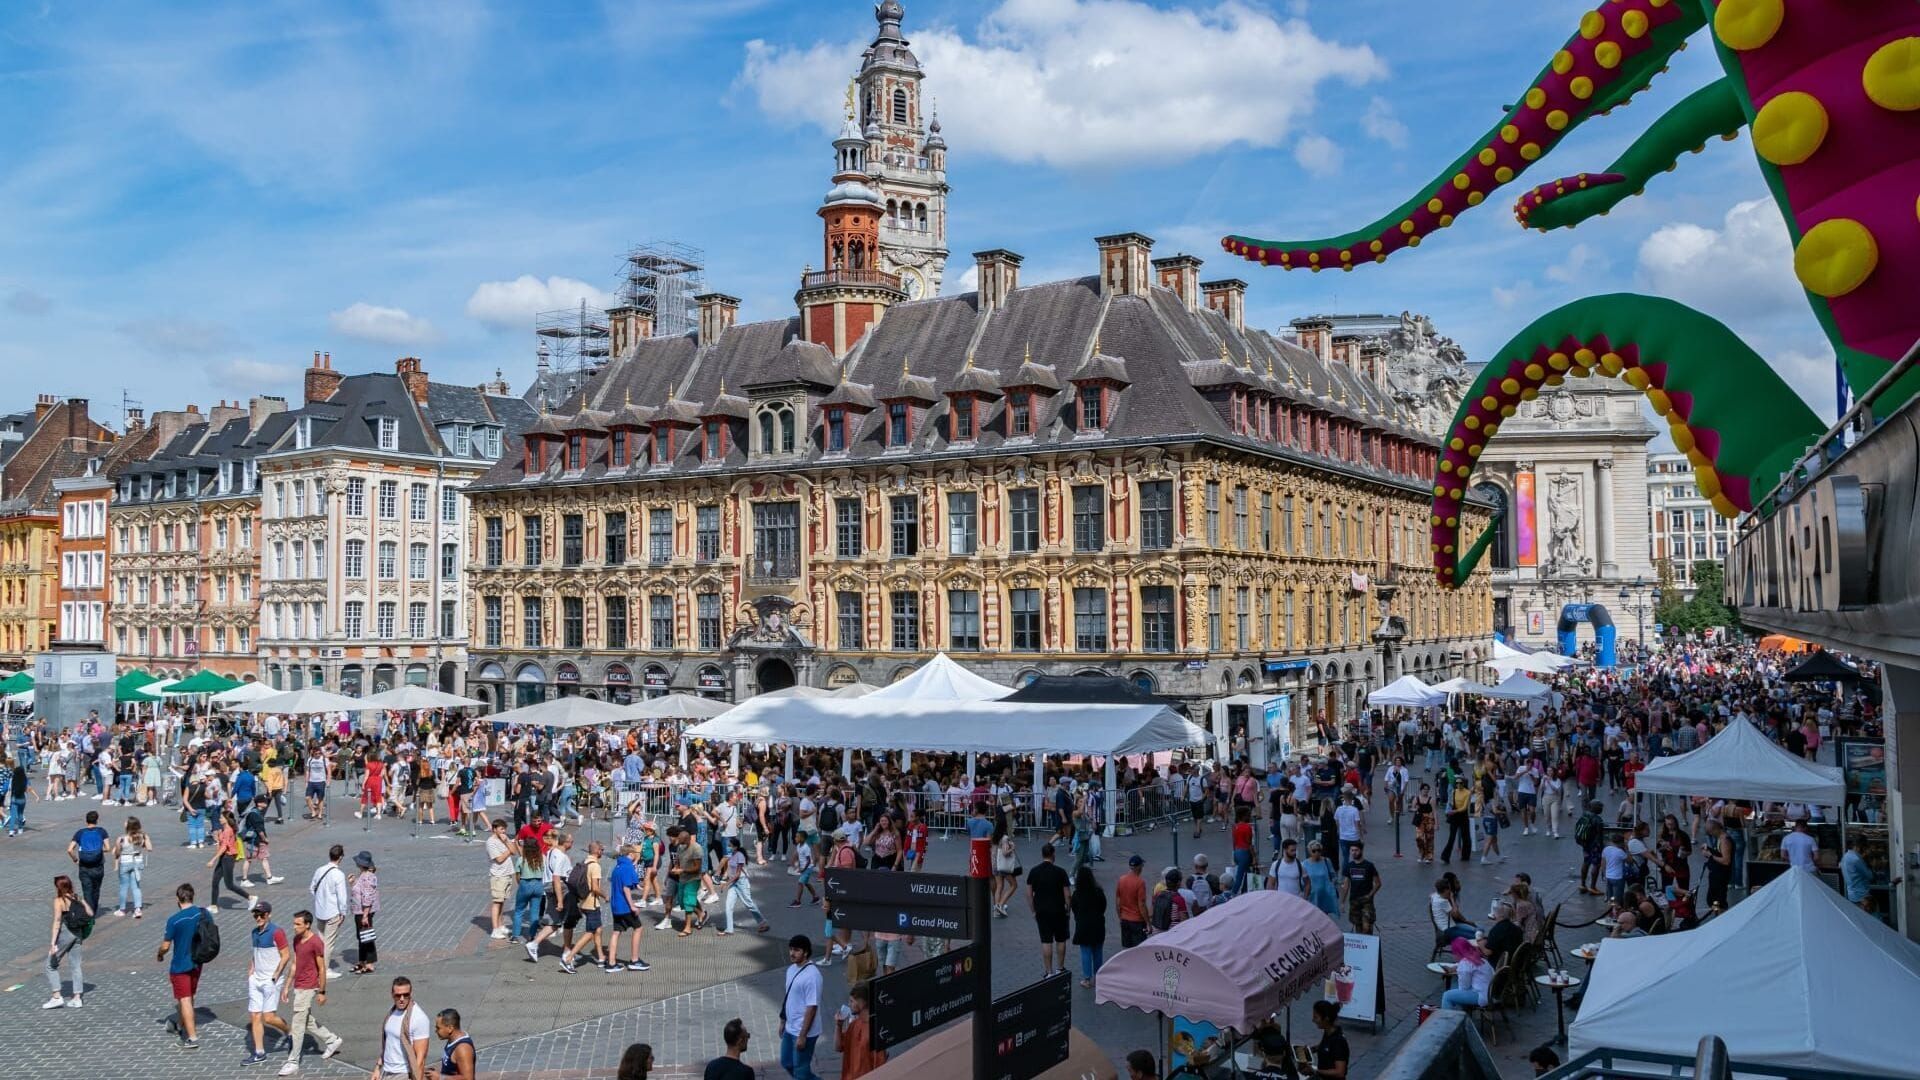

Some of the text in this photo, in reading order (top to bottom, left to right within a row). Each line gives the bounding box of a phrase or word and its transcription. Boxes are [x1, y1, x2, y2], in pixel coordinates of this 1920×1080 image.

[910, 883, 958, 896] VIEUX LILLE
[898, 913, 959, 930] P Grand Place
[1154, 950, 1191, 967] GLACE
[924, 1004, 941, 1021] office
[940, 1002, 949, 1013] de
